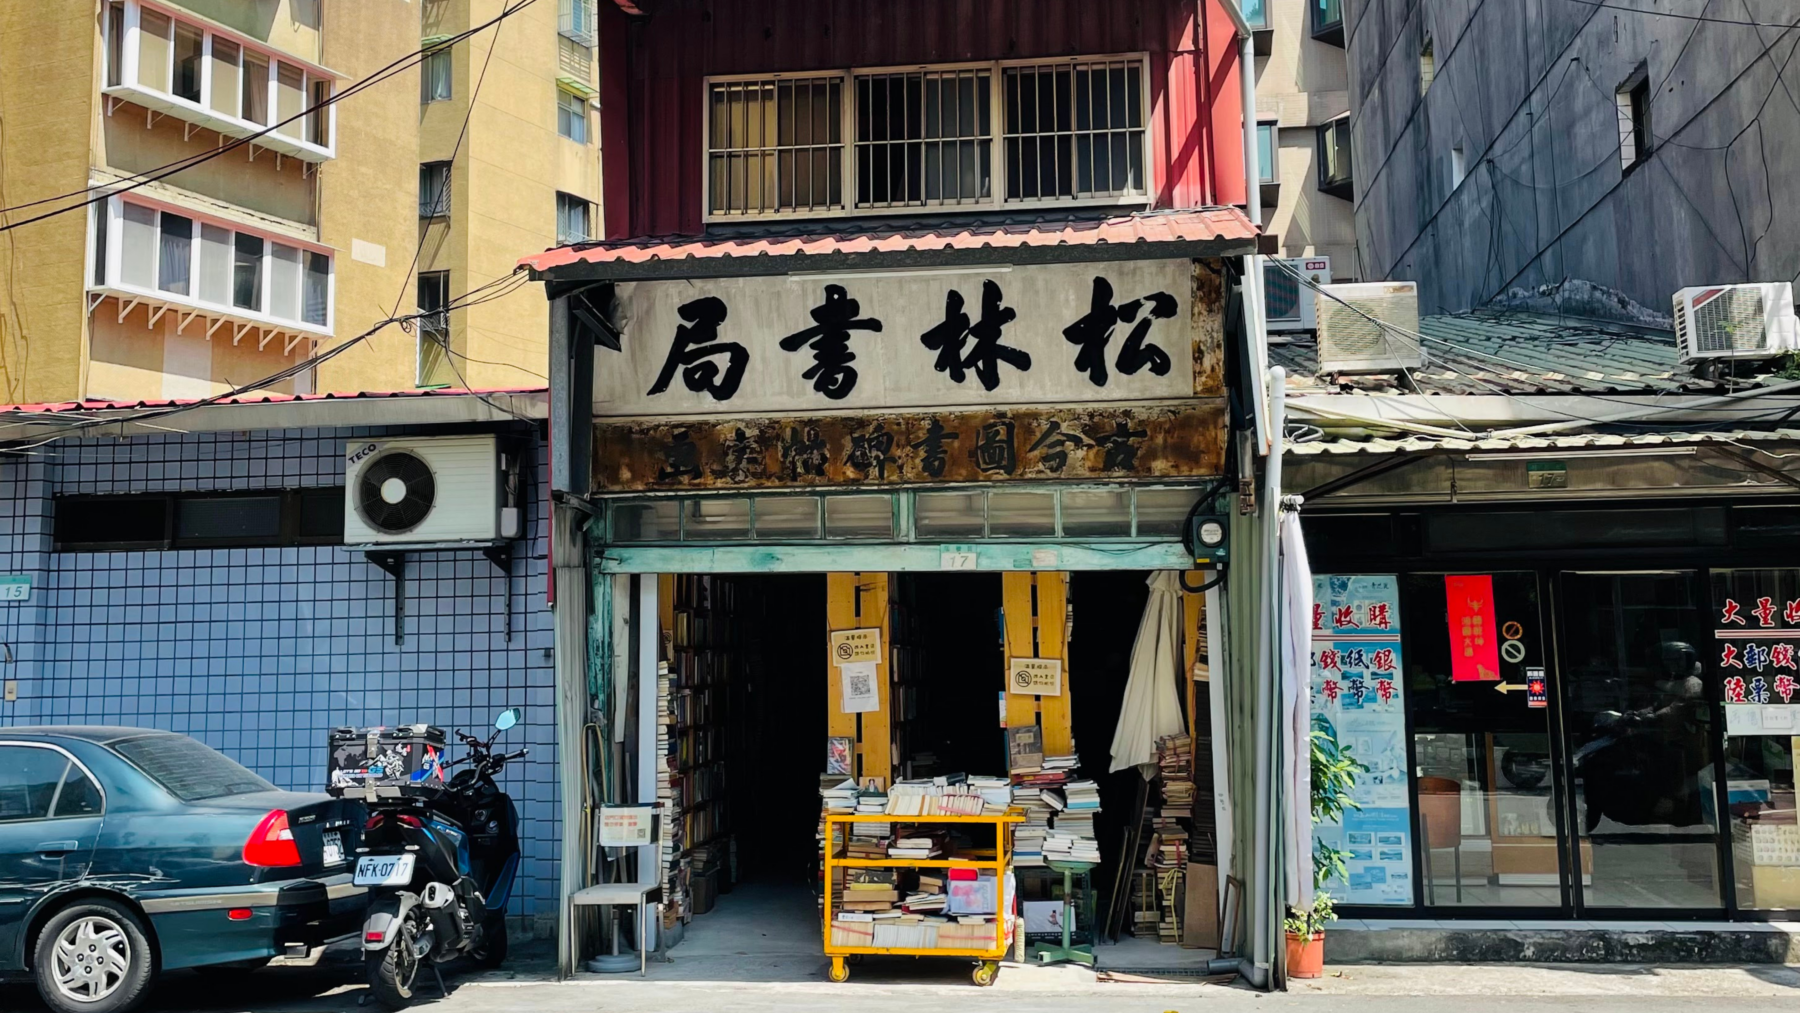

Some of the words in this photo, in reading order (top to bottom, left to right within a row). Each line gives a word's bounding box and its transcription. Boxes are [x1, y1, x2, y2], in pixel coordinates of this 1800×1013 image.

[647, 276, 1178, 401] 松林書局
[348, 443, 376, 464] TECO
[949, 555, 969, 568] 17
[5, 586, 23, 598] 15
[357, 862, 409, 879] NFK-0717
